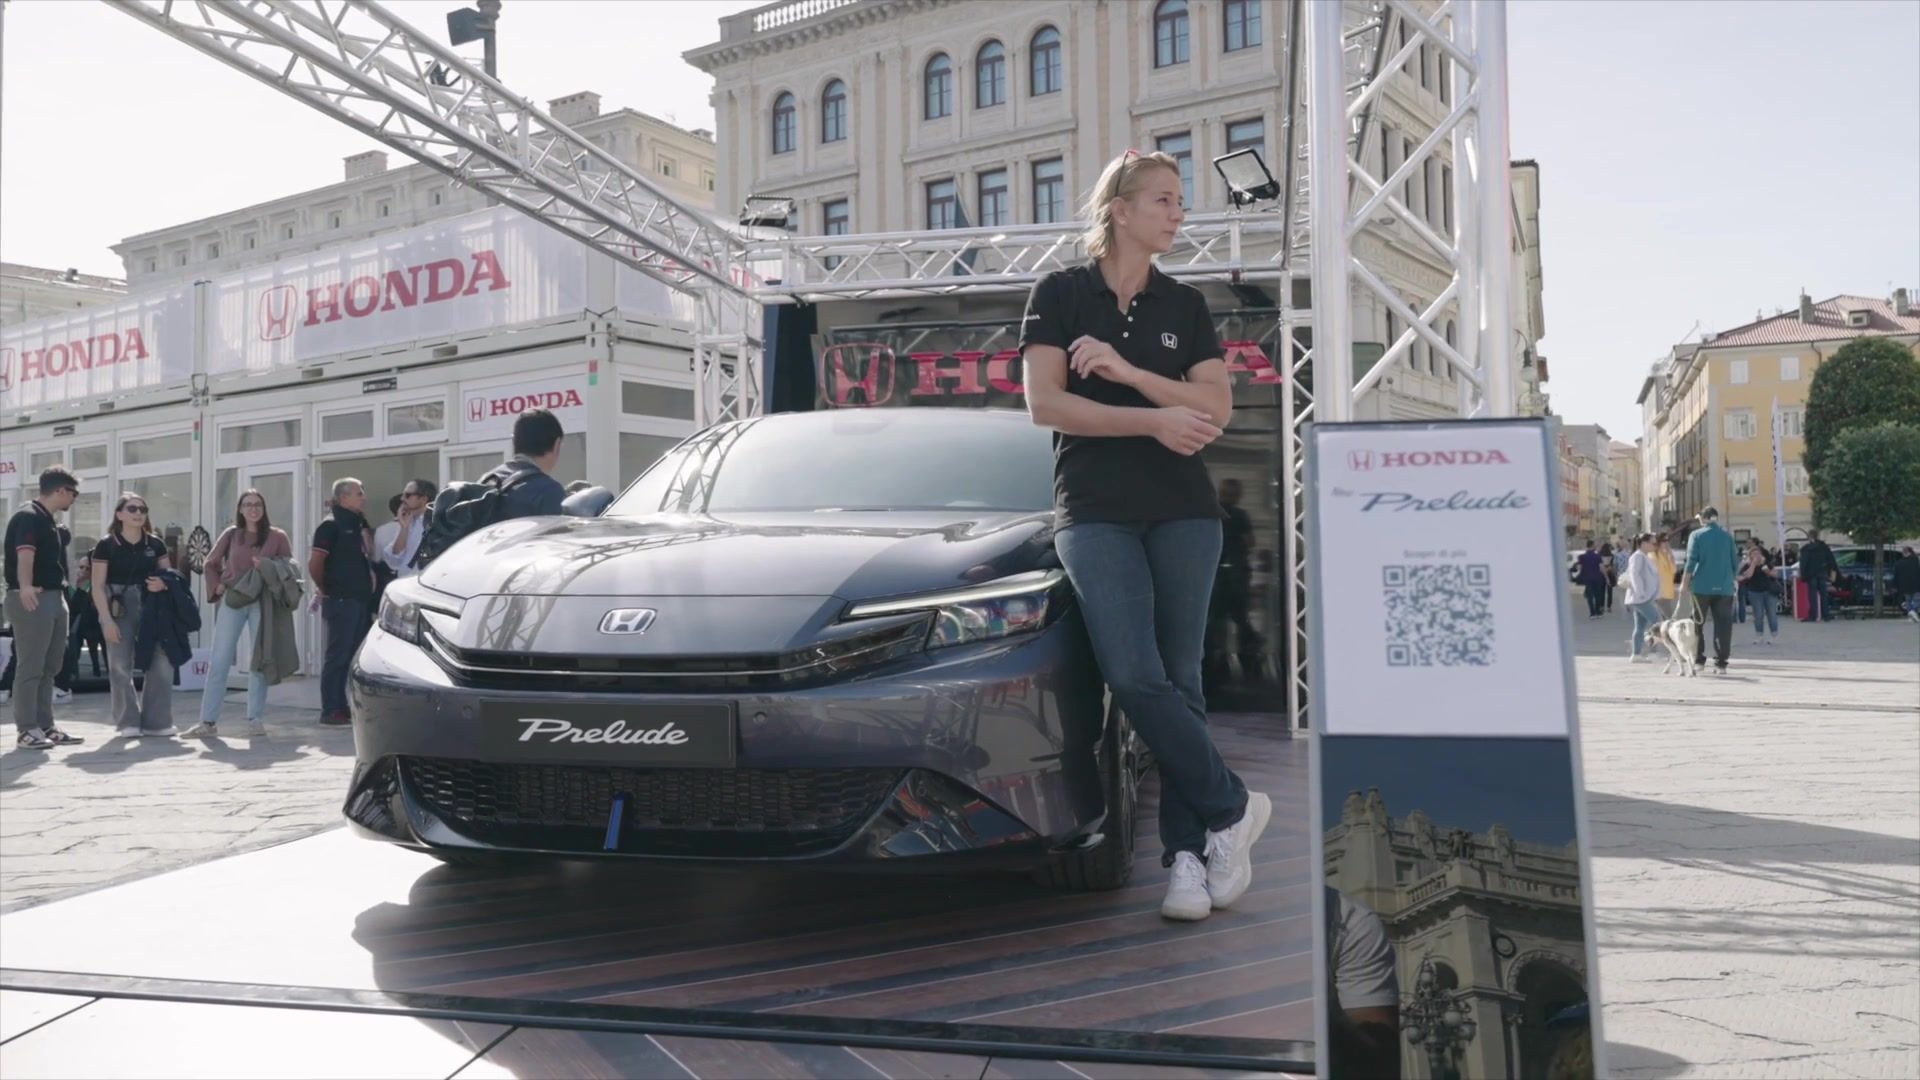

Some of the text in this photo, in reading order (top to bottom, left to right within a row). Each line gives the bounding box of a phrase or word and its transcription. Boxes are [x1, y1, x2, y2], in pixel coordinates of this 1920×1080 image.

[304, 250, 511, 326] HONDA
[21, 327, 149, 382] HONDA
[490, 389, 583, 416] HONDA
[1381, 449, 1511, 467] HONDA
[1359, 489, 1531, 512] Prelude
[517, 717, 689, 745] Prelude
